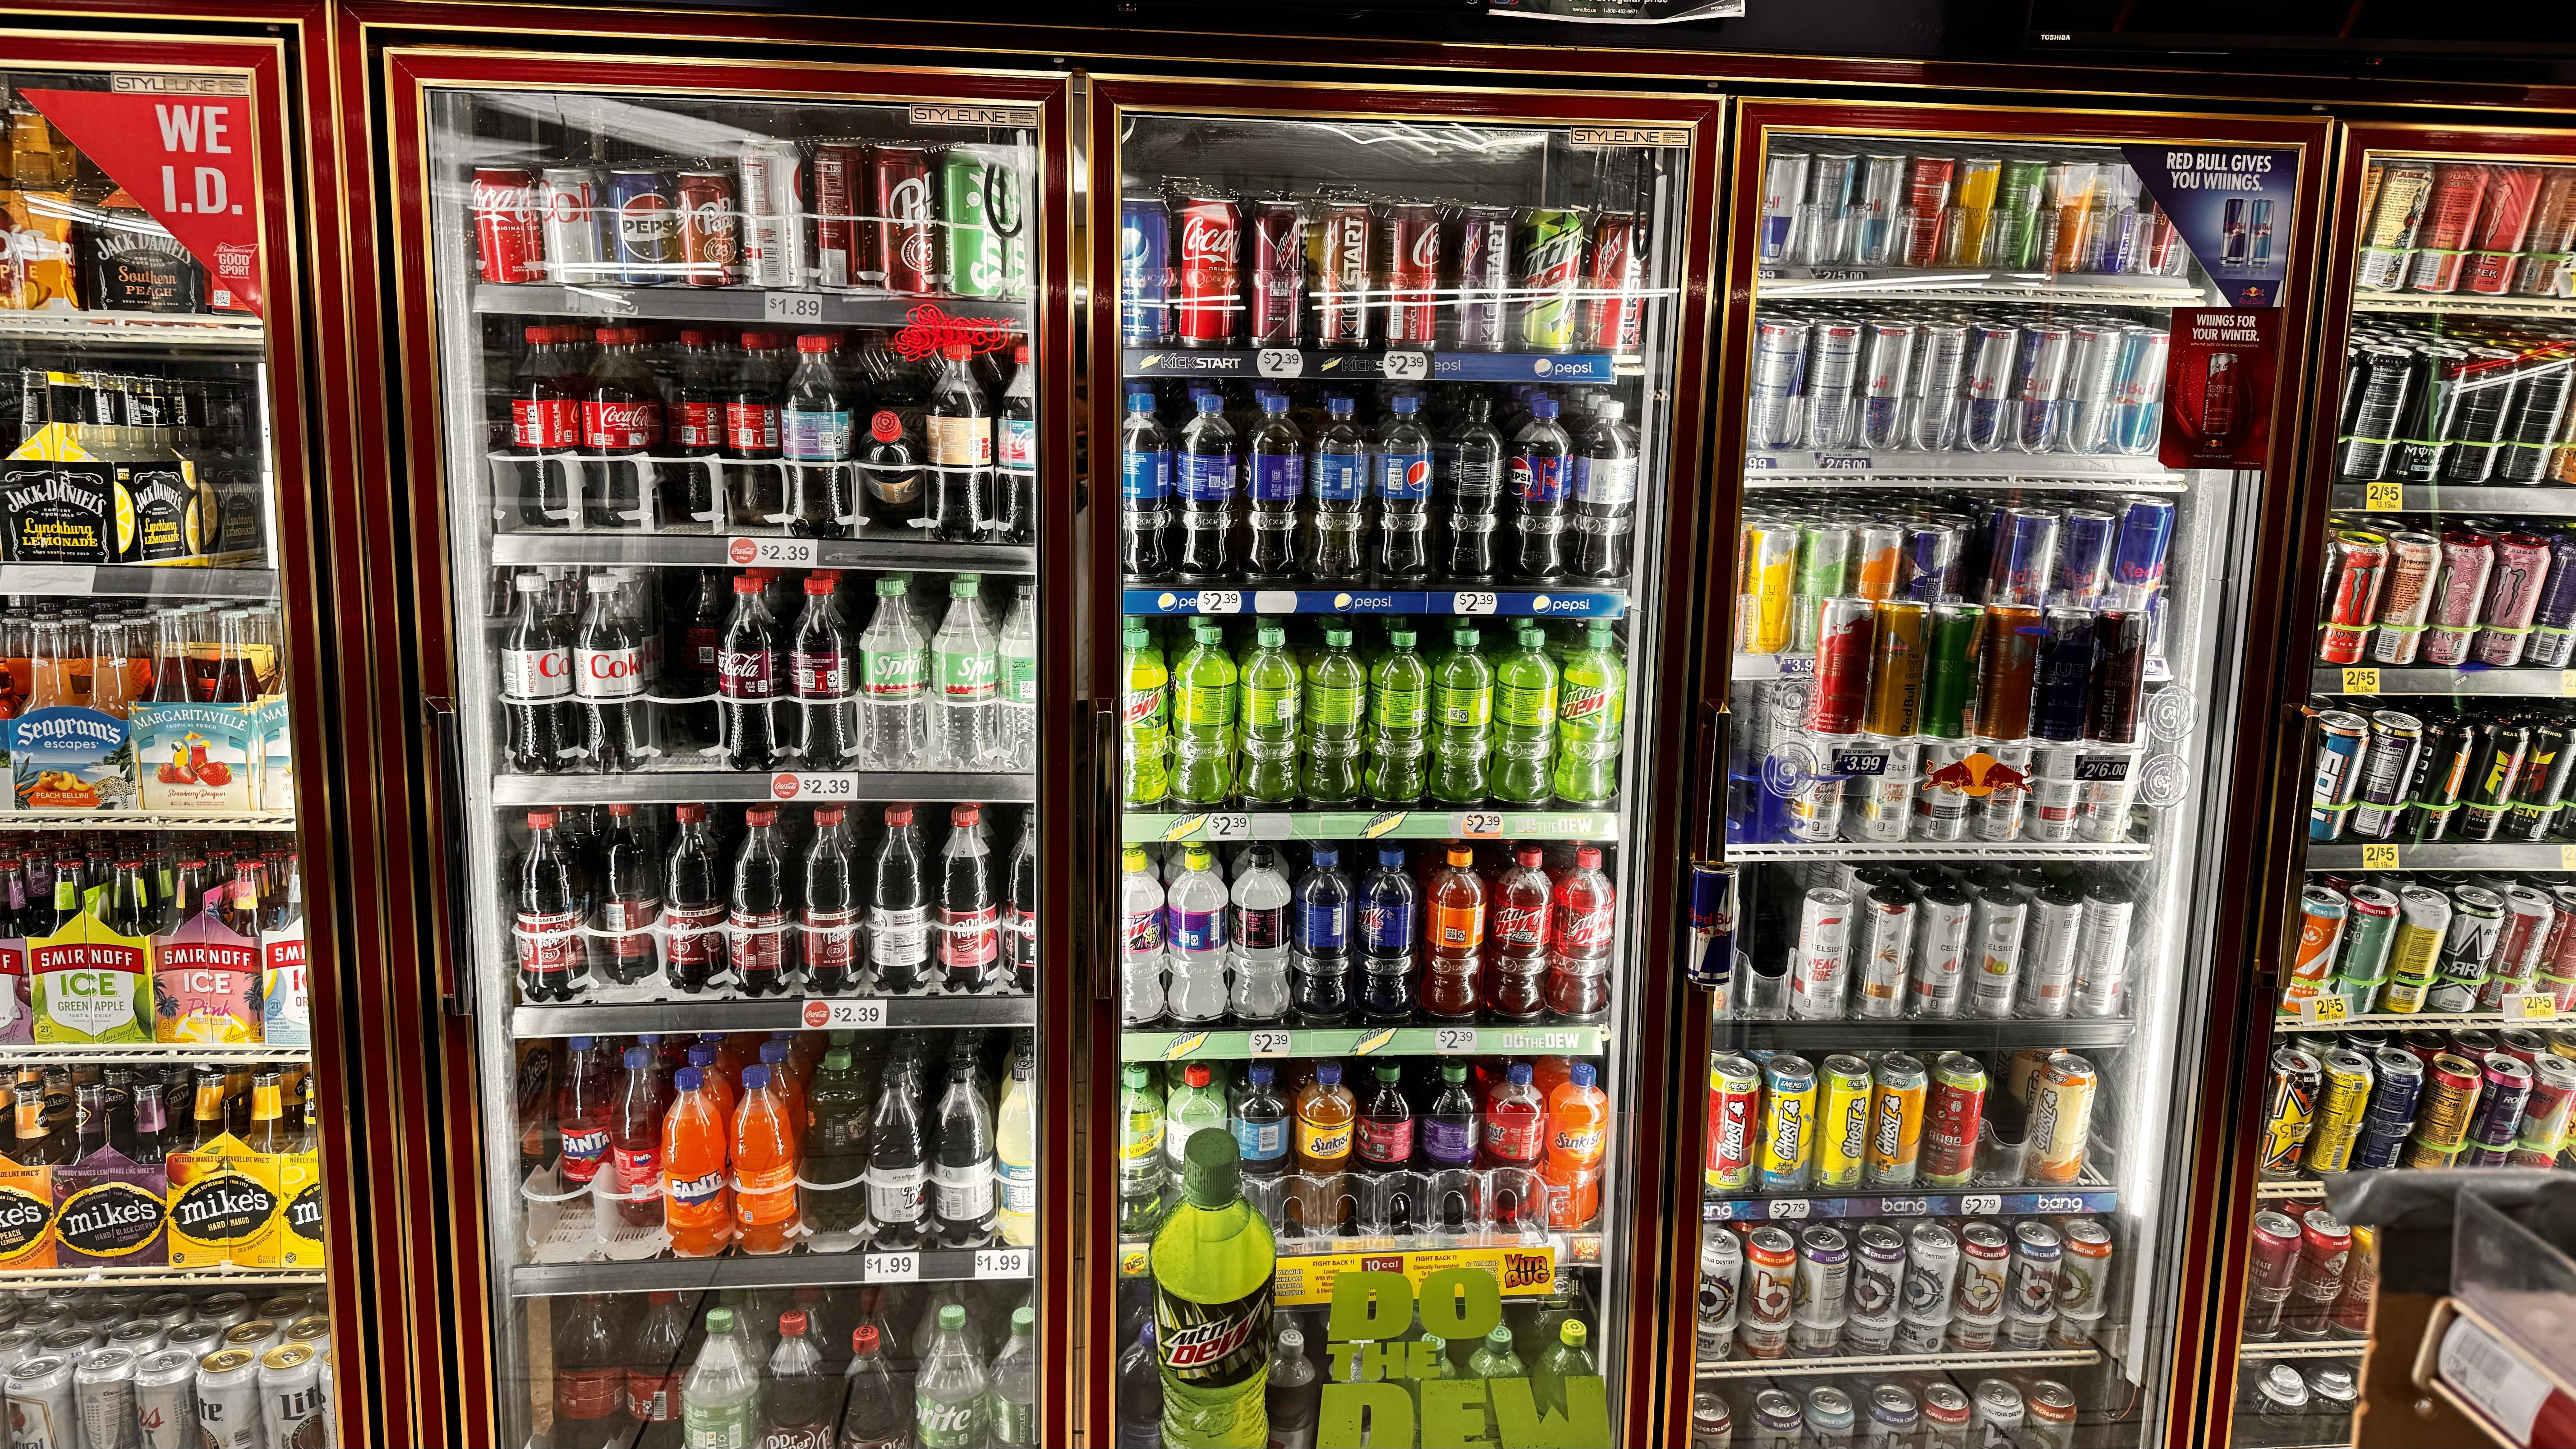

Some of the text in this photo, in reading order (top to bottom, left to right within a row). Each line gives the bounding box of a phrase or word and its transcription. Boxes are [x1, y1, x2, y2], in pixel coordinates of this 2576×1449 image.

[914, 108, 1006, 123] STYLELINE
[156, 104, 231, 153] WE
[1574, 130, 1659, 143] STYLELINE
[2167, 152, 2271, 172] RED BULL GIVES
[2171, 172, 2263, 191] YOU WIIINGS.
[162, 166, 243, 215] I.D.
[219, 254, 249, 265] GOOD
[119, 266, 177, 284] Southern
[220, 266, 249, 275] SPORT
[126, 286, 173, 297] PEACH
[1270, 281, 1288, 290] BLACK
[770, 298, 819, 316] $1.89
[2197, 315, 2255, 327] WIIINGS FOR
[2192, 328, 2259, 341] YOUR WINTER.
[1161, 353, 1241, 369] KICKSTART
[1264, 354, 1299, 371] $2.39
[1389, 356, 1424, 374] $2.39
[1555, 361, 1593, 375] pepsi
[552, 403, 559, 414] ME
[2369, 486, 2399, 500] 2/$5
[23, 518, 94, 542] Lynchburg
[145, 518, 177, 539] Lynchburg
[23, 537, 97, 547] LEMONADE
[145, 532, 179, 545] LEMONADE
[762, 545, 810, 561] $2.39
[1203, 593, 1237, 611] $2.39
[1354, 595, 1392, 609] pepsi
[1460, 594, 1493, 611] $2.39
[1553, 600, 1590, 612] pepsi
[2346, 671, 2375, 685] 2/$5
[1901, 684, 1915, 732] Red Bull
[18, 718, 121, 746] Seagram's
[44, 740, 97, 750] escapes
[1845, 756, 1880, 771] $3.99
[804, 779, 850, 794] $2.39
[1213, 816, 1247, 835] $2.39
[1467, 815, 1500, 833] $2.39
[1537, 823, 1557, 833] THE
[1559, 818, 1592, 833] DEW
[2366, 847, 2395, 861] 2/$5
[1811, 943, 1843, 953] CELSIUS
[1983, 942, 2014, 952] CELSIUS
[41, 948, 133, 967] SMIRNOFF
[165, 948, 251, 966] SMIRNOFF
[60, 973, 117, 996] ICE
[58, 1000, 125, 1012] GREEN APPLE
[187, 997, 231, 1018] Pink
[2316, 999, 2344, 1014] 2/$5
[2526, 997, 2551, 1009] 2/$5
[834, 1007, 879, 1022] $2.39
[1255, 1035, 1288, 1053] $2.39
[1440, 1031, 1473, 1049] $2.39
[1503, 1033, 1580, 1049] DO THE DEW
[2045, 1070, 2068, 1083] ENERGY
[1725, 1082, 1750, 1090] ENERGY
[1780, 1081, 1805, 1089] ENERGY
[1842, 1108, 1867, 1158] GHOST
[1875, 1104, 1902, 1159] GHOST
[2031, 1096, 2057, 1154] GHOST
[563, 1131, 611, 1153] FANTA
[1311, 1131, 1351, 1153] Sunkist
[1555, 1130, 1601, 1148] Sunkist
[1721, 1109, 1746, 1162] GHOST
[1774, 1112, 1801, 1162] GHOST
[633, 1154, 652, 1162] FANTA
[180, 1188, 269, 1225] mike's
[1774, 1202, 1805, 1218] $2.79
[1883, 1198, 1927, 1215] bang
[1965, 1199, 1995, 1214] $2.79
[2038, 1195, 2083, 1212] bang
[65, 1200, 156, 1236] mike's
[207, 1217, 249, 1231] HARD MANGO
[0, 1229, 21, 1240] PEACH
[95, 1221, 156, 1241] HARD BLACK CHERRY
[0, 1236, 25, 1246] LEMONADE
[866, 1257, 912, 1274] $1.99
[977, 1255, 1021, 1271] $1.99
[1365, 1260, 1398, 1271] 10 cal
[1504, 1254, 1546, 1270] VITA
[1505, 1268, 1550, 1288] BUG
[1328, 1268, 1502, 1341] DO
[1326, 1341, 1440, 1381] THE
[1316, 1375, 1611, 1449] DEW
[1926, 1410, 1942, 1420] SUPER
